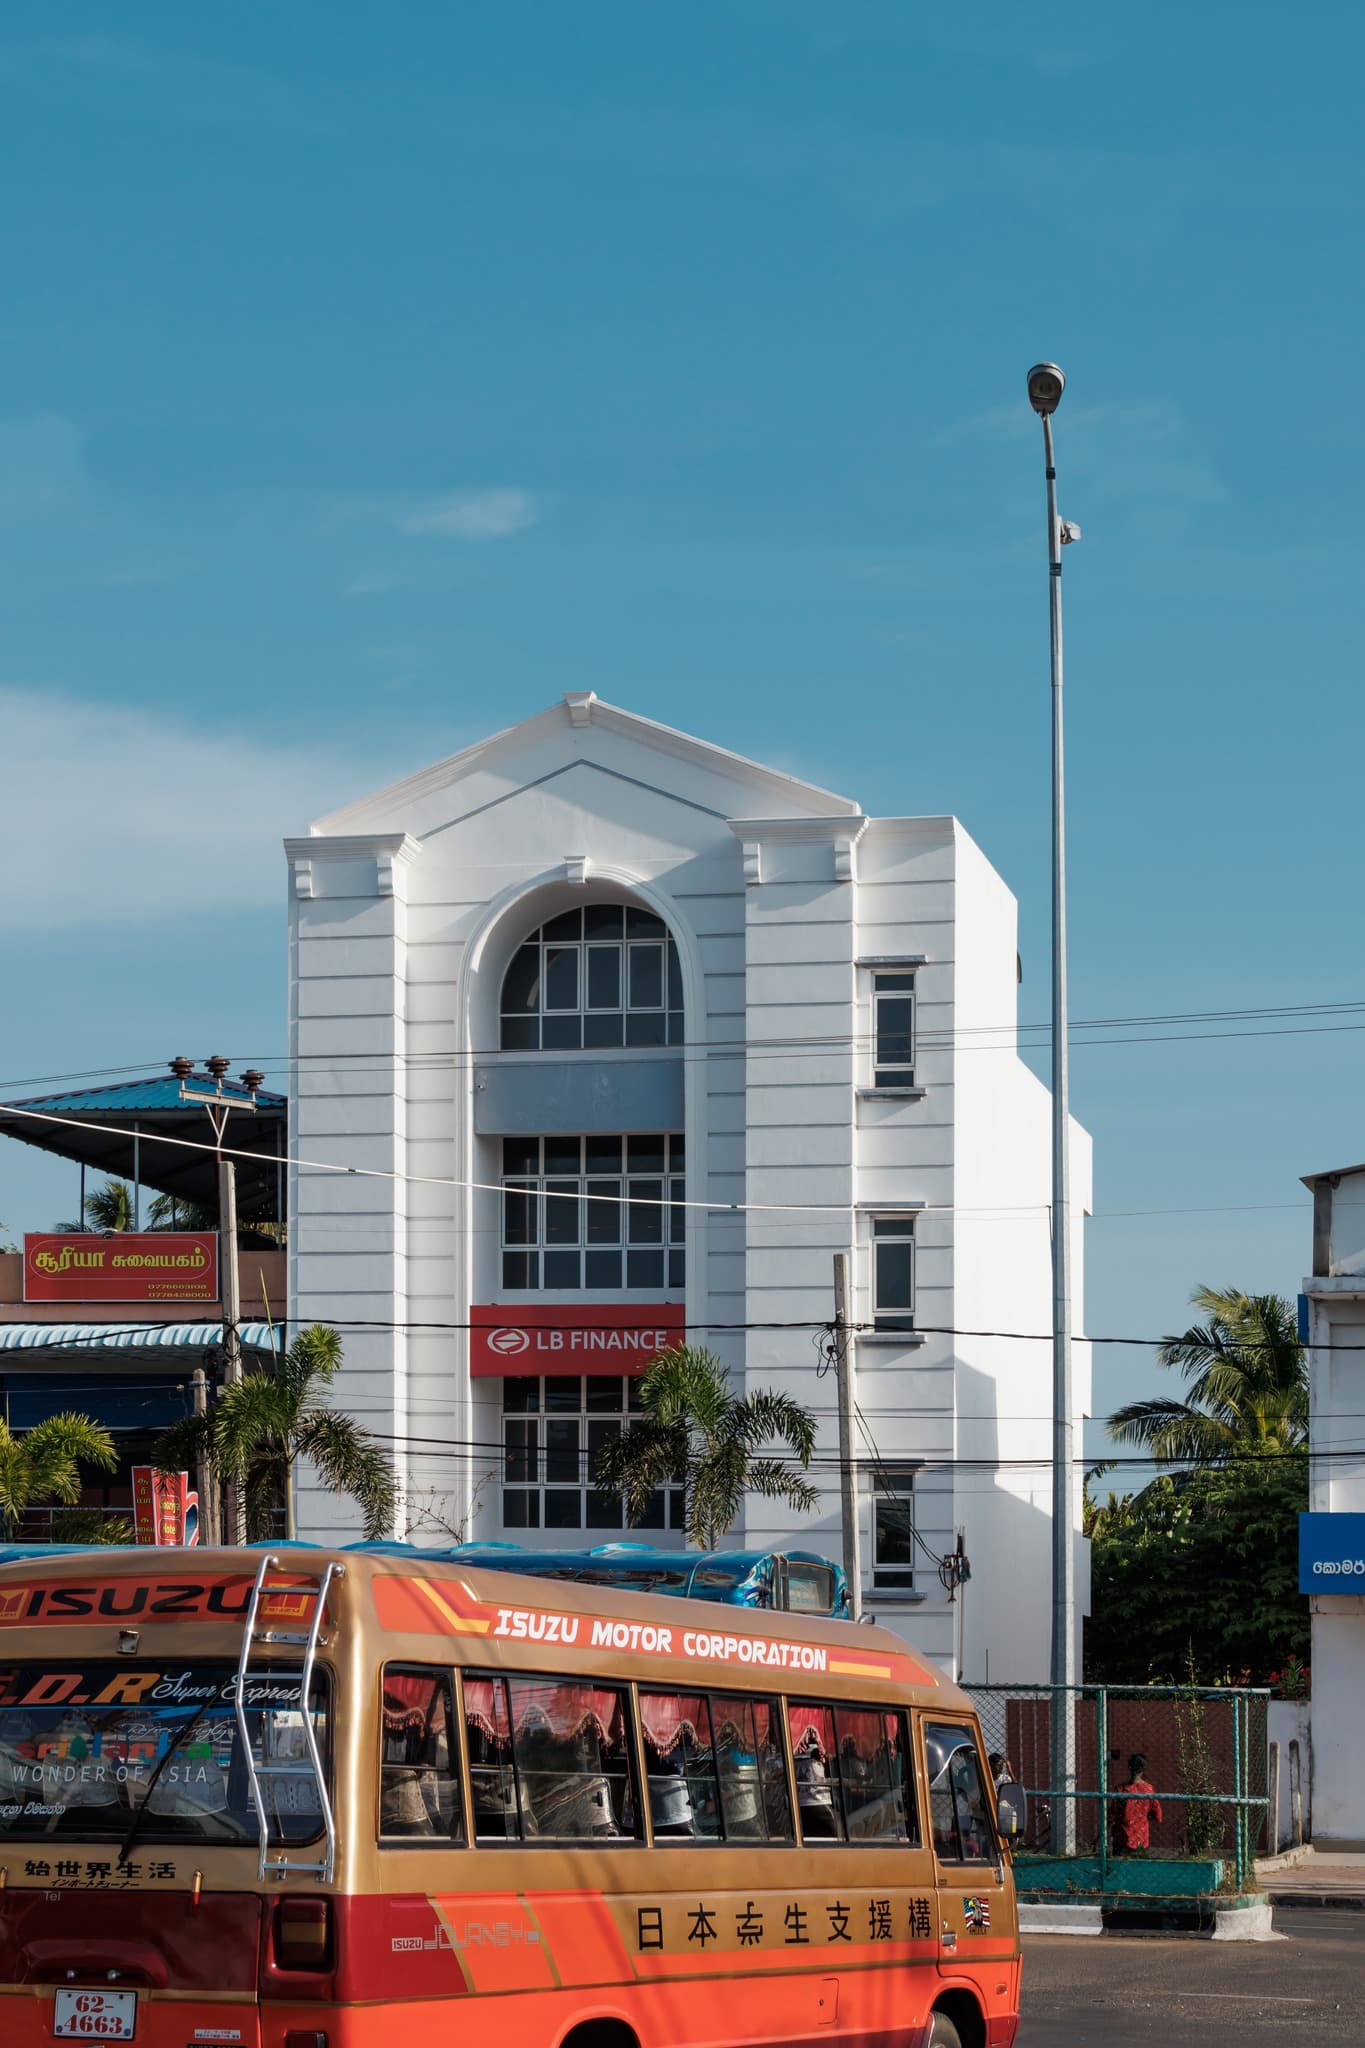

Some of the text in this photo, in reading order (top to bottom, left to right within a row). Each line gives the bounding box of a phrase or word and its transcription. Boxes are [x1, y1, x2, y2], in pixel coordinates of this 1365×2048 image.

[35, 1246, 205, 1273] சூரியா சுவையகம்
[537, 1331, 667, 1350] LB FINANCE
[26, 1584, 253, 1616] ISUZU
[493, 1608, 827, 1671] ISUZU MOTOR CORPORATION
[151, 1672, 216, 1702] Super
[221, 1674, 304, 1704] Express
[12, 1766, 208, 1782] WONDER OF SIA
[24, 1860, 177, 1879] 始世界生活
[44, 1891, 61, 1901] Tel
[393, 1939, 422, 1950] ISUZU
[75, 1995, 114, 2013] 62-
[64, 2015, 123, 2034] 4663
